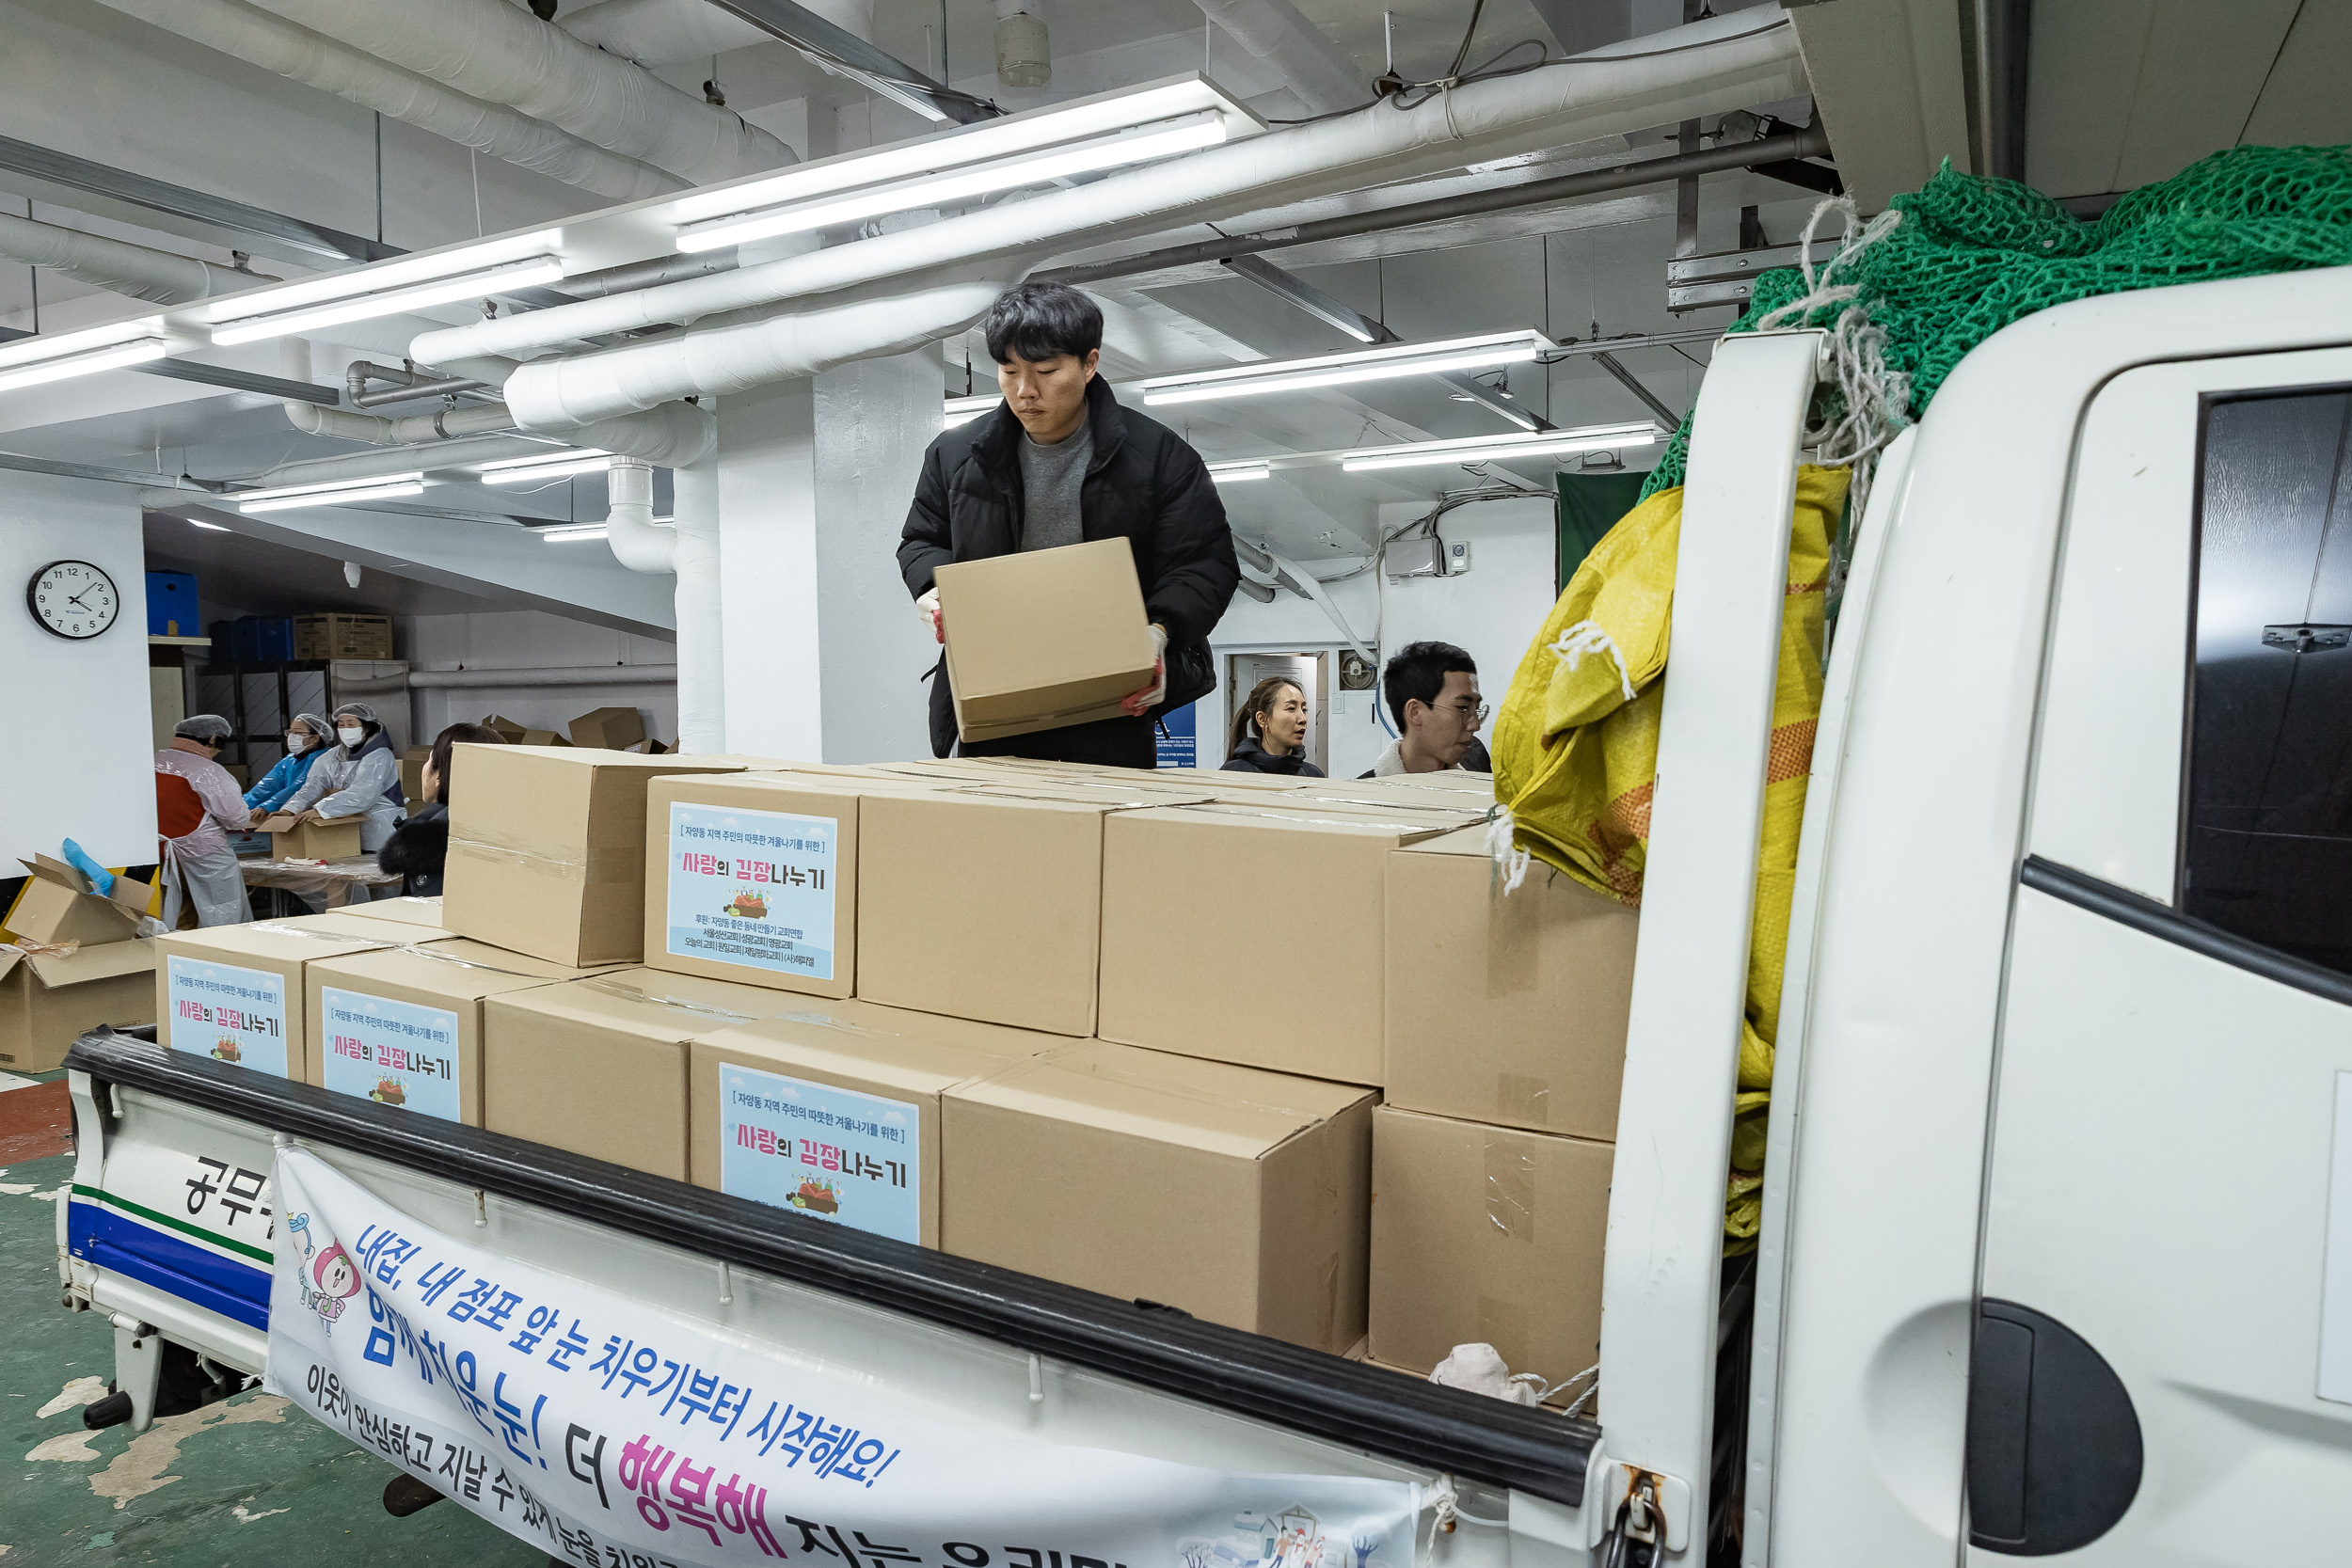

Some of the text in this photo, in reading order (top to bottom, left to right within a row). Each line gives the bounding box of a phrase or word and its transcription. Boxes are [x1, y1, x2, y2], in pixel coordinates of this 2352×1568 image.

[54, 570, 63, 578] 11
[67, 568, 79, 577] 12
[85, 572, 90, 580] 1
[42, 581, 53, 590] 10
[97, 583, 104, 593] 2
[39, 594, 46, 603] 9
[102, 597, 109, 606] 3
[44, 610, 52, 618] 8
[56, 619, 63, 628] 7
[685, 827, 706, 839] 자양동
[707, 829, 721, 840] 지역
[723, 831, 743, 843] 주민의
[745, 833, 766, 846] 따뜻한
[768, 836, 803, 850] 겨울나기를
[805, 840, 820, 852] 위한
[682, 852, 825, 890] 사랑의 김장나누기
[711, 917, 730, 928] 자양동
[730, 920, 743, 930] 좋은
[743, 921, 756, 932] 동네
[757, 924, 777, 936] 만들기
[777, 926, 803, 940] 교회연합
[179, 999, 279, 1037] 사랑의 김장나누기
[334, 1035, 451, 1081] 사랑의 김장나누기
[738, 1093, 762, 1109] 자양동
[764, 1099, 780, 1115] 지역
[782, 1102, 806, 1120] 주민의
[808, 1109, 834, 1127] 따뜻한
[835, 1115, 879, 1137] 겨울나기를
[881, 1126, 898, 1142] 위한
[737, 1123, 906, 1189] 사랑의 김장나누기
[185, 1155, 274, 1241] 공무
[417, 1261, 467, 1307] 내
[447, 1277, 524, 1332] 점포
[508, 1306, 560, 1355] 앞
[547, 1319, 589, 1372] 눈
[588, 1334, 753, 1442] 치우기부터
[746, 1400, 901, 1489] 시작해요!
[307, 1364, 602, 1568] 이웃이 안심하고 지날 수 있게 눈을
[564, 1422, 611, 1511] 더
[618, 1433, 789, 1560] 행복해
